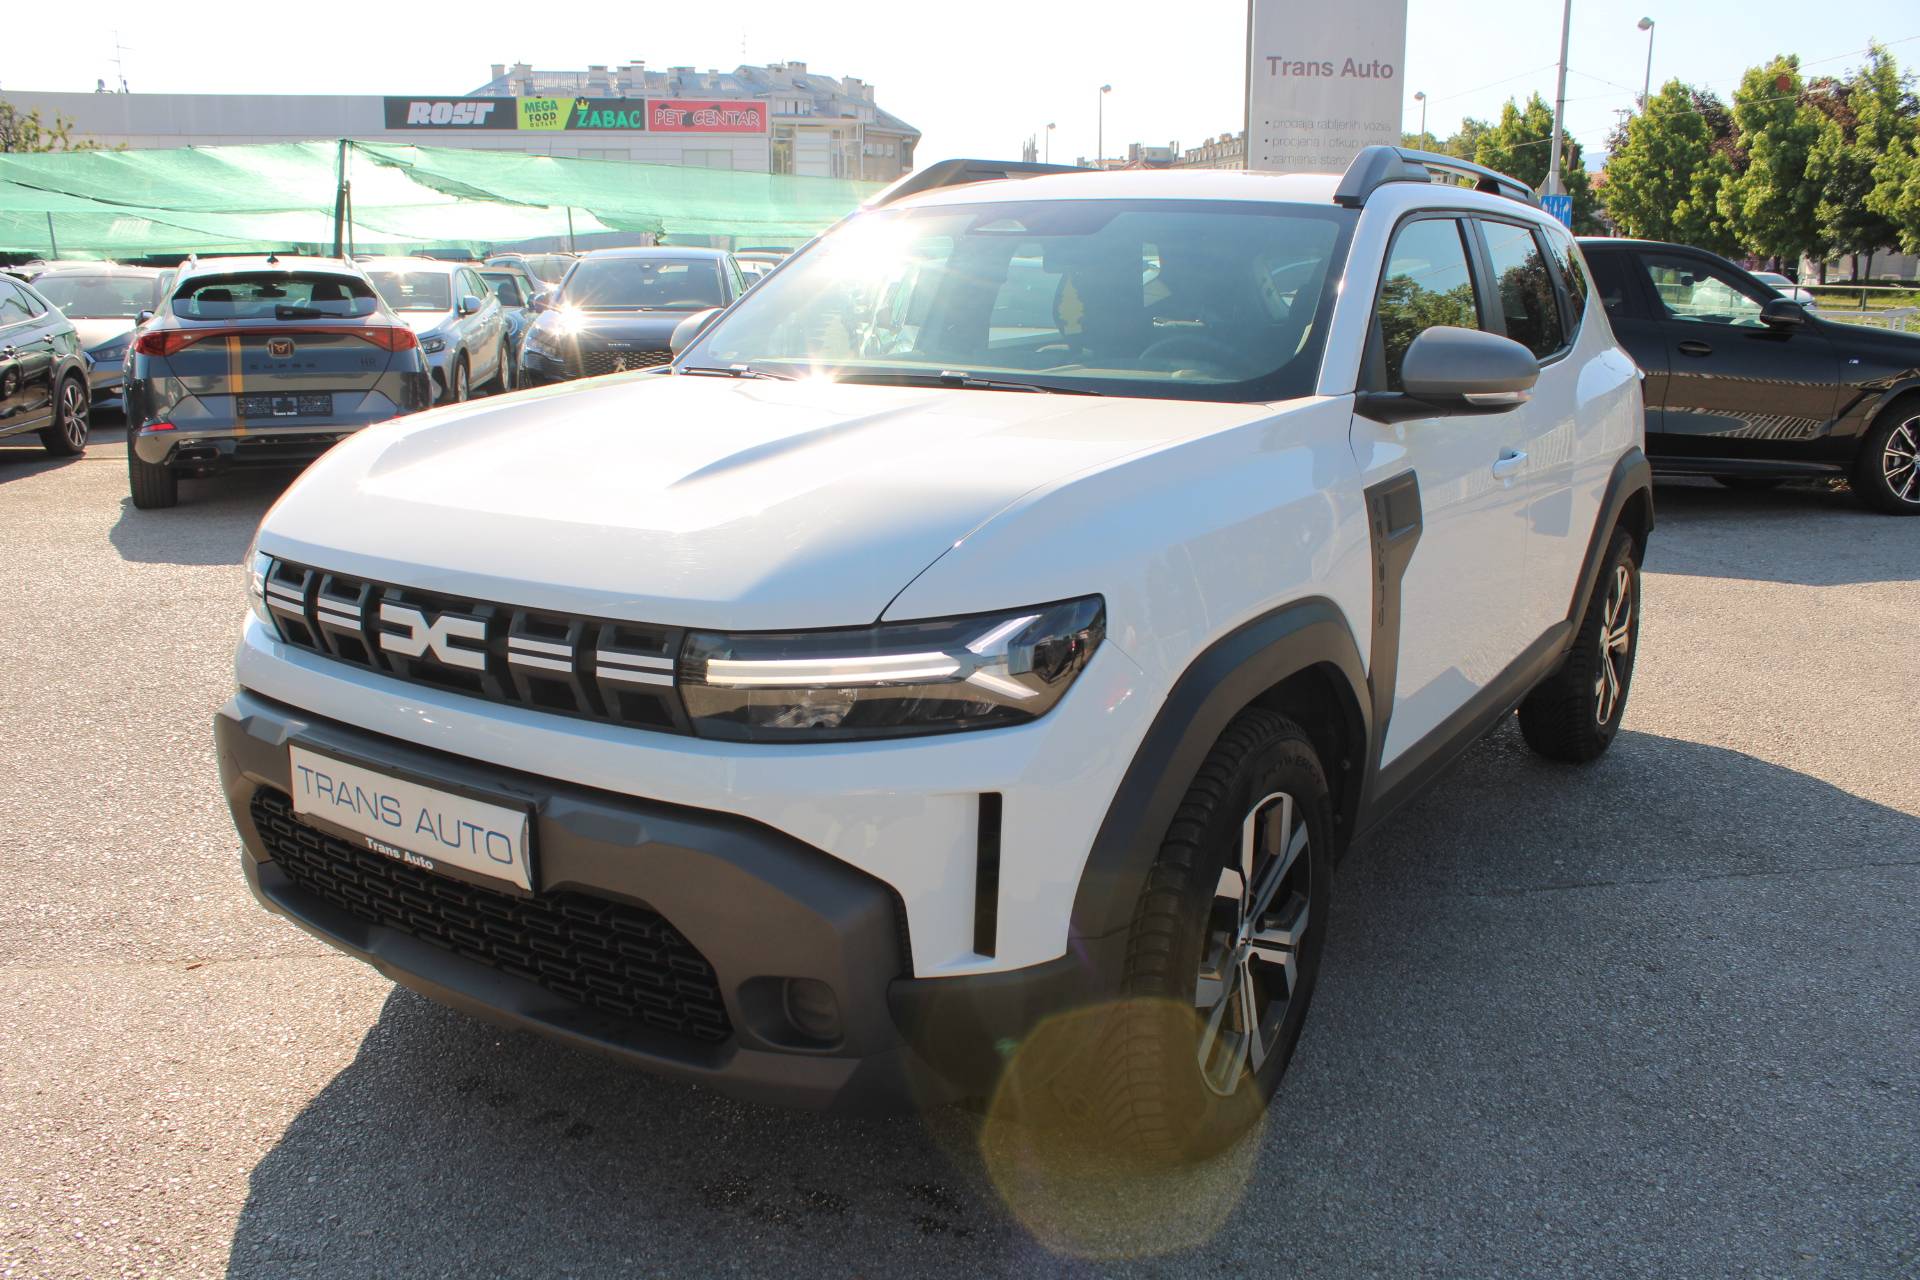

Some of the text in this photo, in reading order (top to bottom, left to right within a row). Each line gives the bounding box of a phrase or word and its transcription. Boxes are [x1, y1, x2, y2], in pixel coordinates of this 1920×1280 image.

[1266, 56, 1394, 79] Trans Auto
[524, 100, 559, 113] MEGA
[529, 112, 557, 122] FOOD
[655, 109, 761, 127] PET CENTAR
[298, 764, 513, 865] TRANS AUTO
[365, 837, 434, 870] Trans Auto
